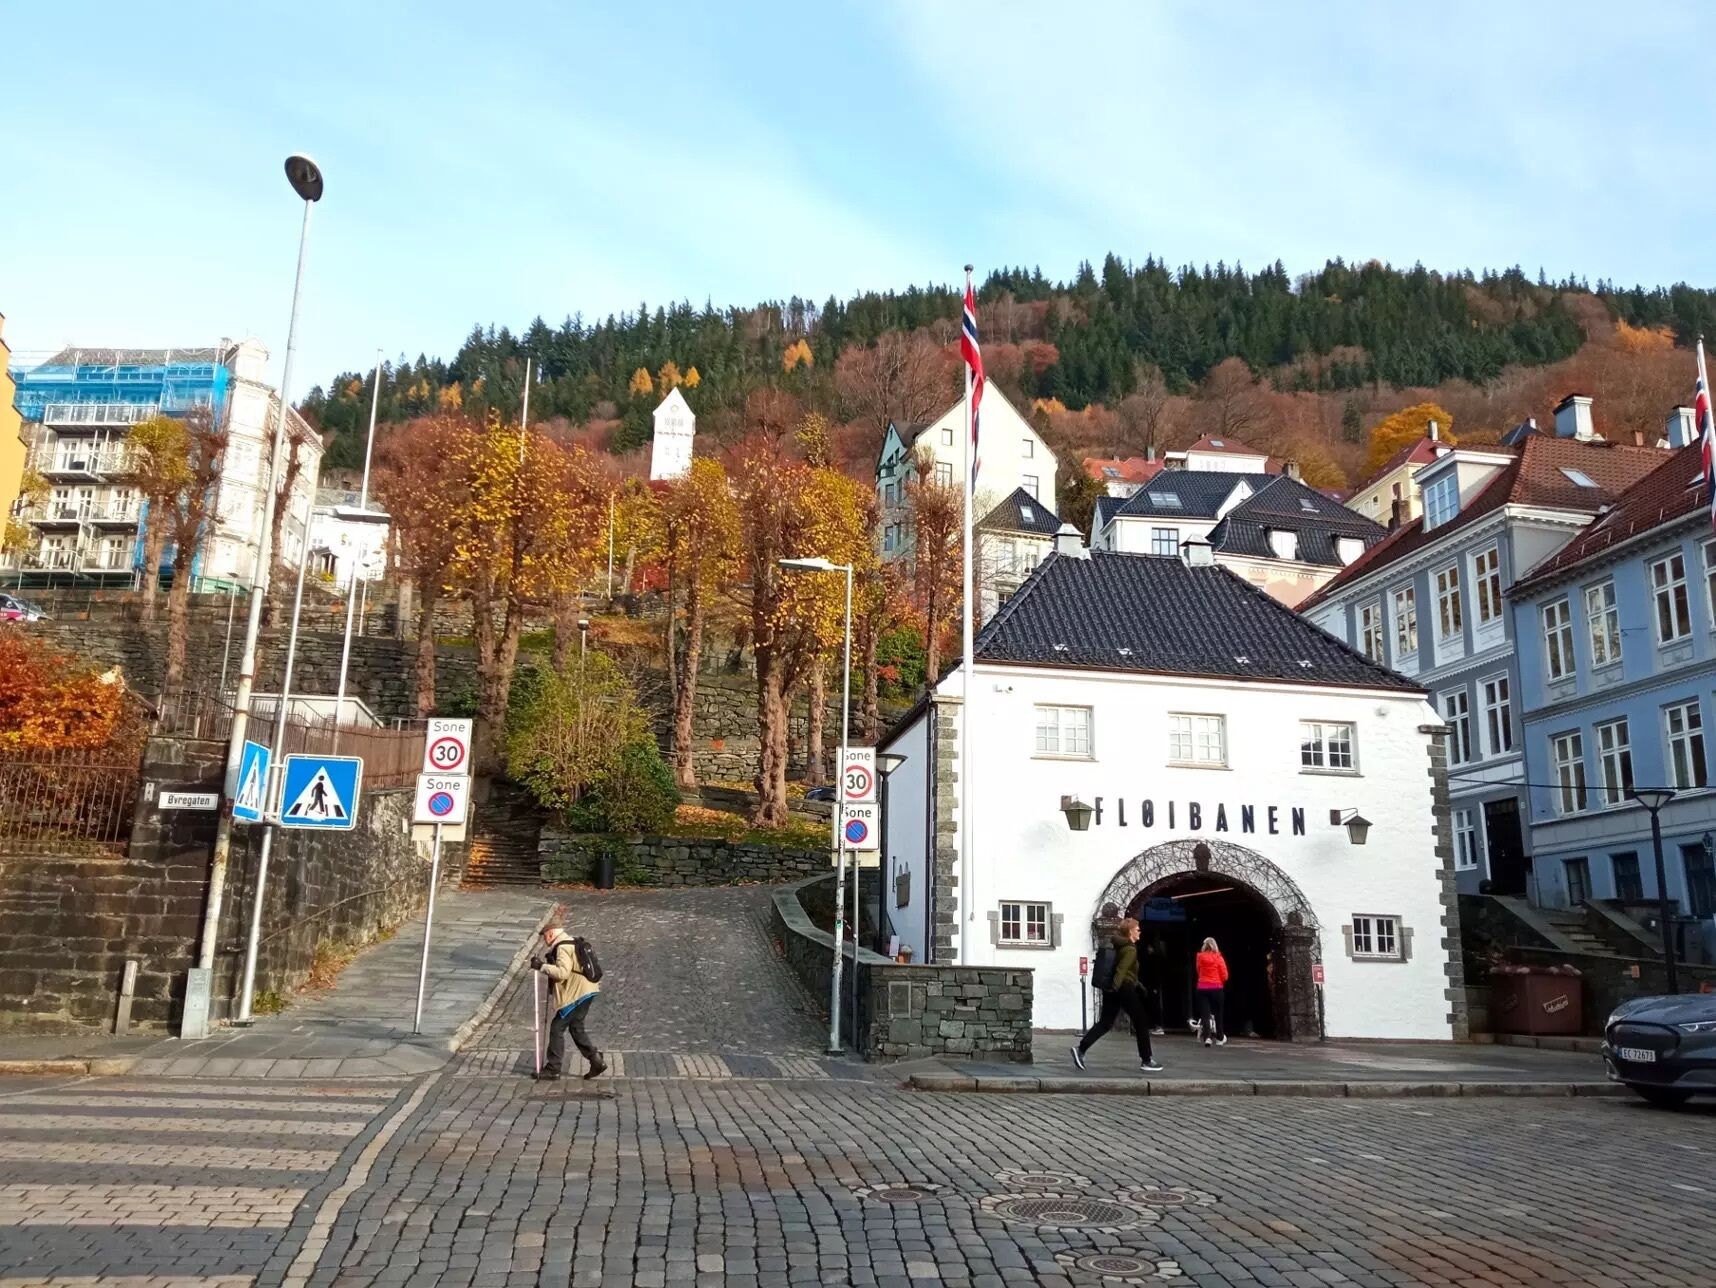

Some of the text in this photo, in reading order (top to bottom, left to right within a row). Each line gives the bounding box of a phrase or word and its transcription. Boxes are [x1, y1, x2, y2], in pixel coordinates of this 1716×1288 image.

[433, 721, 466, 732] Sone
[436, 745, 458, 761] 30
[426, 778, 460, 790] Sone
[846, 774, 867, 790] 30
[167, 794, 210, 807] Øvregaten
[1095, 796, 1305, 836] FLØIBANEN
